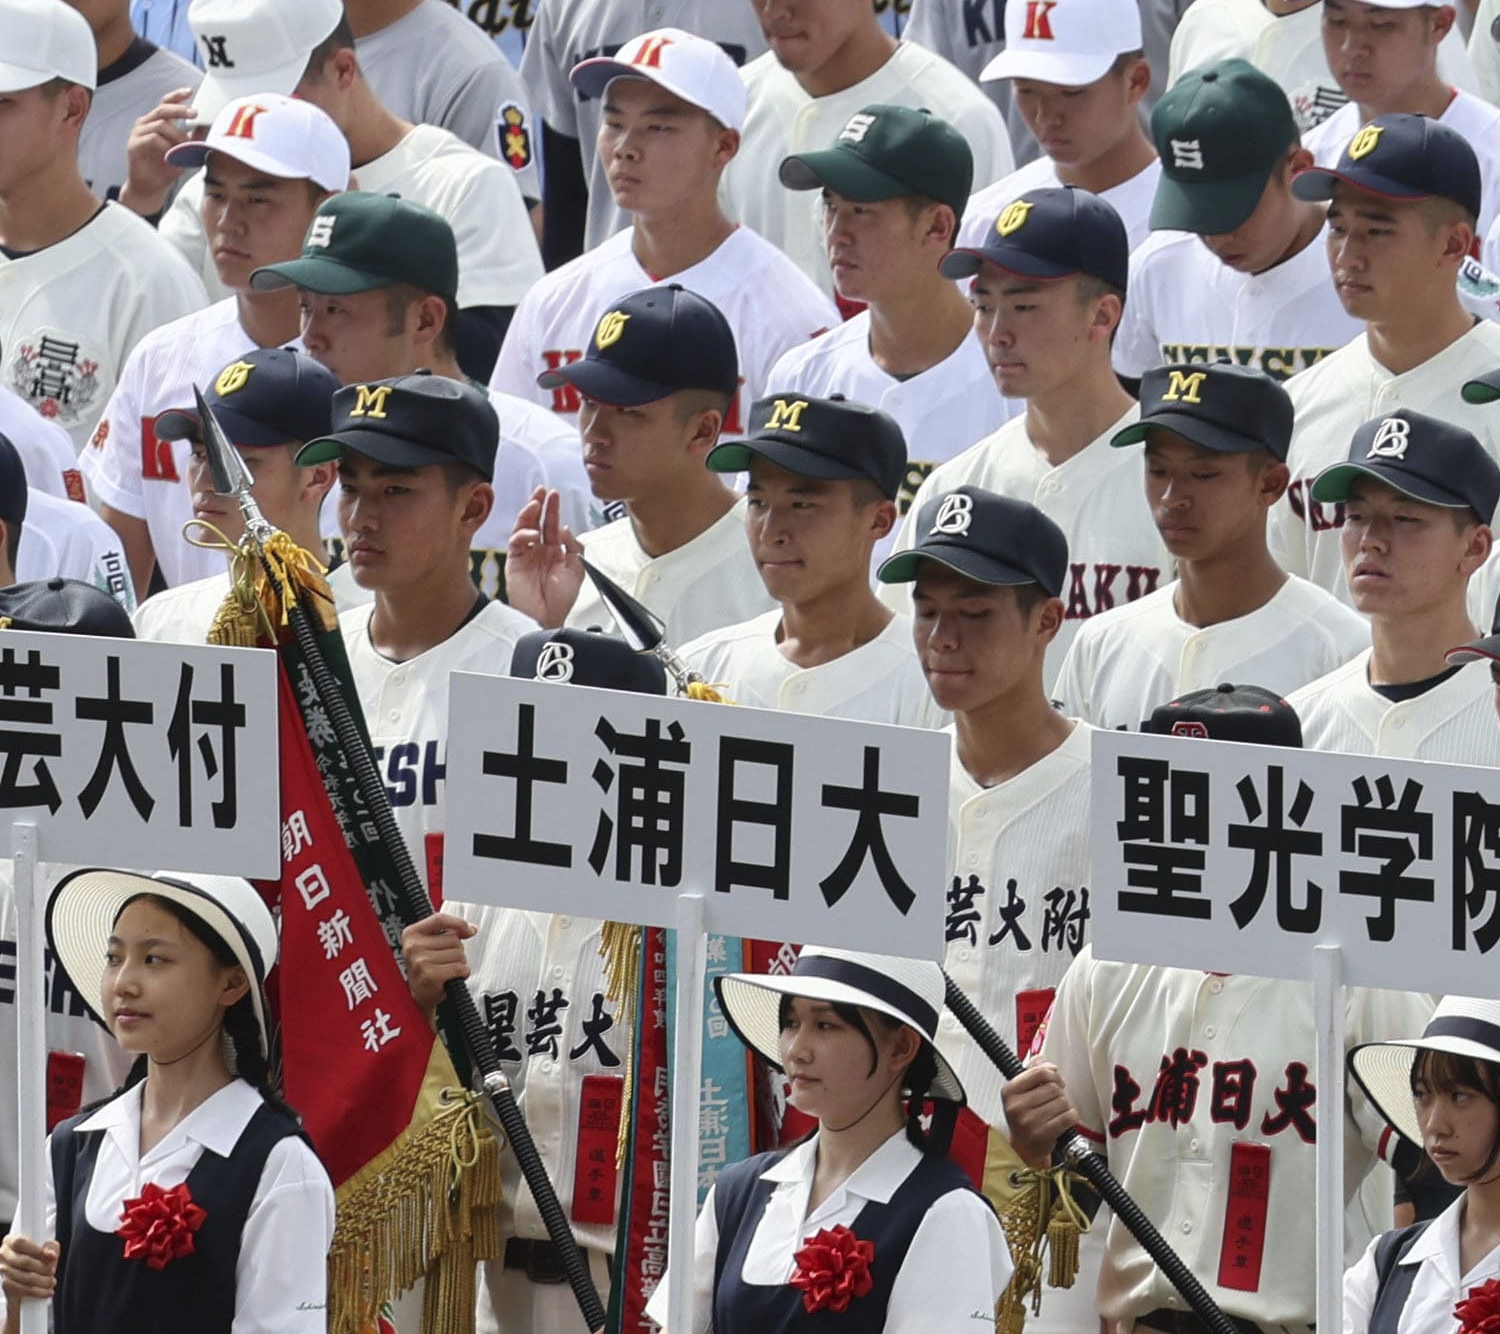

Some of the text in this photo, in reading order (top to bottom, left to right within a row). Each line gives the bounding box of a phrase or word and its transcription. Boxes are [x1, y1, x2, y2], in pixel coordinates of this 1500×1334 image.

[1022, 0, 1056, 40] K
[201, 34, 235, 69] N
[632, 36, 673, 69] K
[226, 105, 269, 138] K
[348, 385, 392, 420] M
[1161, 369, 1207, 404] M
[472, 704, 921, 917] 土浦日大
[282, 809, 401, 1054] 朝日新聞社
[1109, 1050, 1318, 1143] 土浦日大
